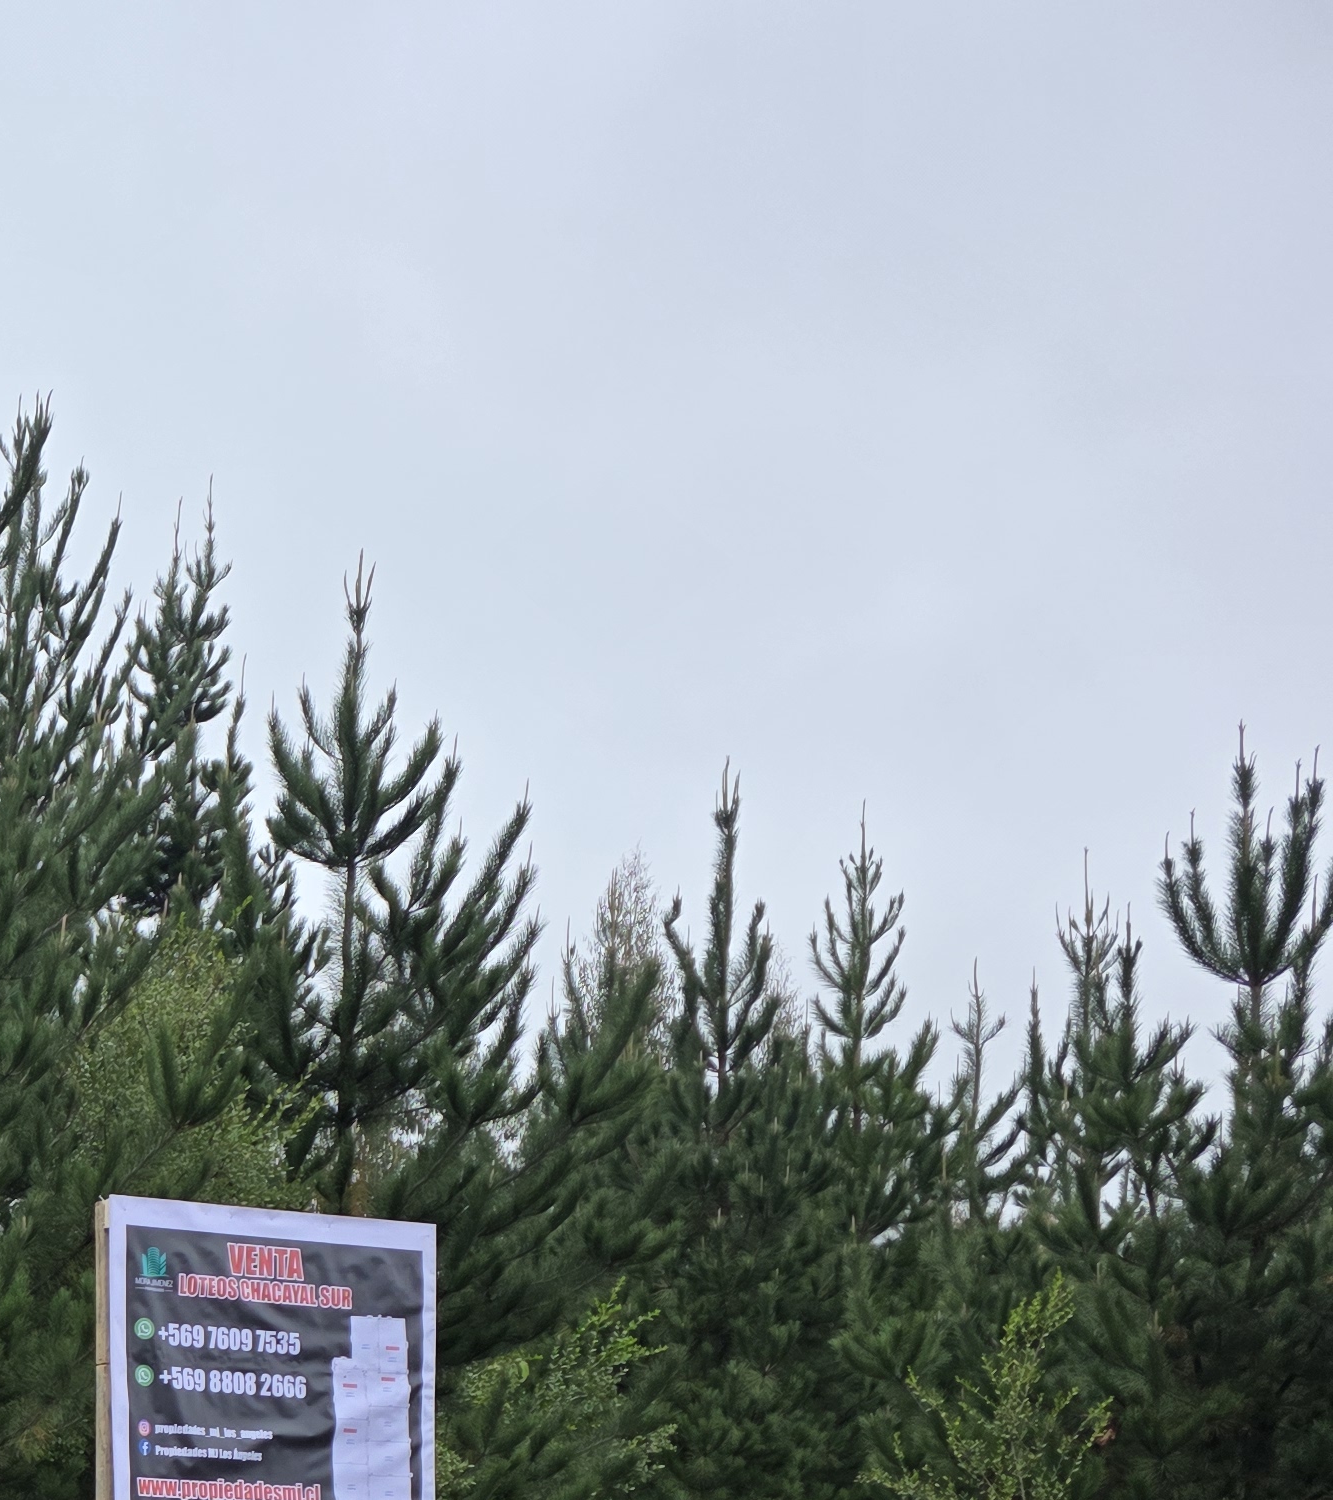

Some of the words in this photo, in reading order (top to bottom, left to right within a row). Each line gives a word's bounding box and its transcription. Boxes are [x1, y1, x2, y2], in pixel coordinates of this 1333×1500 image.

[227, 1242, 304, 1281] VENTA
[178, 1273, 239, 1300] LOTEOS
[240, 1279, 318, 1307] CHACAYAL
[319, 1285, 352, 1309] SUR
[158, 1323, 205, 1348] +569
[208, 1326, 253, 1351] 7609
[256, 1330, 301, 1355] 7535
[159, 1366, 206, 1392] +569
[209, 1370, 257, 1396] 8808
[260, 1373, 307, 1399] 2666
[155, 1445, 207, 1458] Propiedades
[219, 1449, 232, 1459] Los
